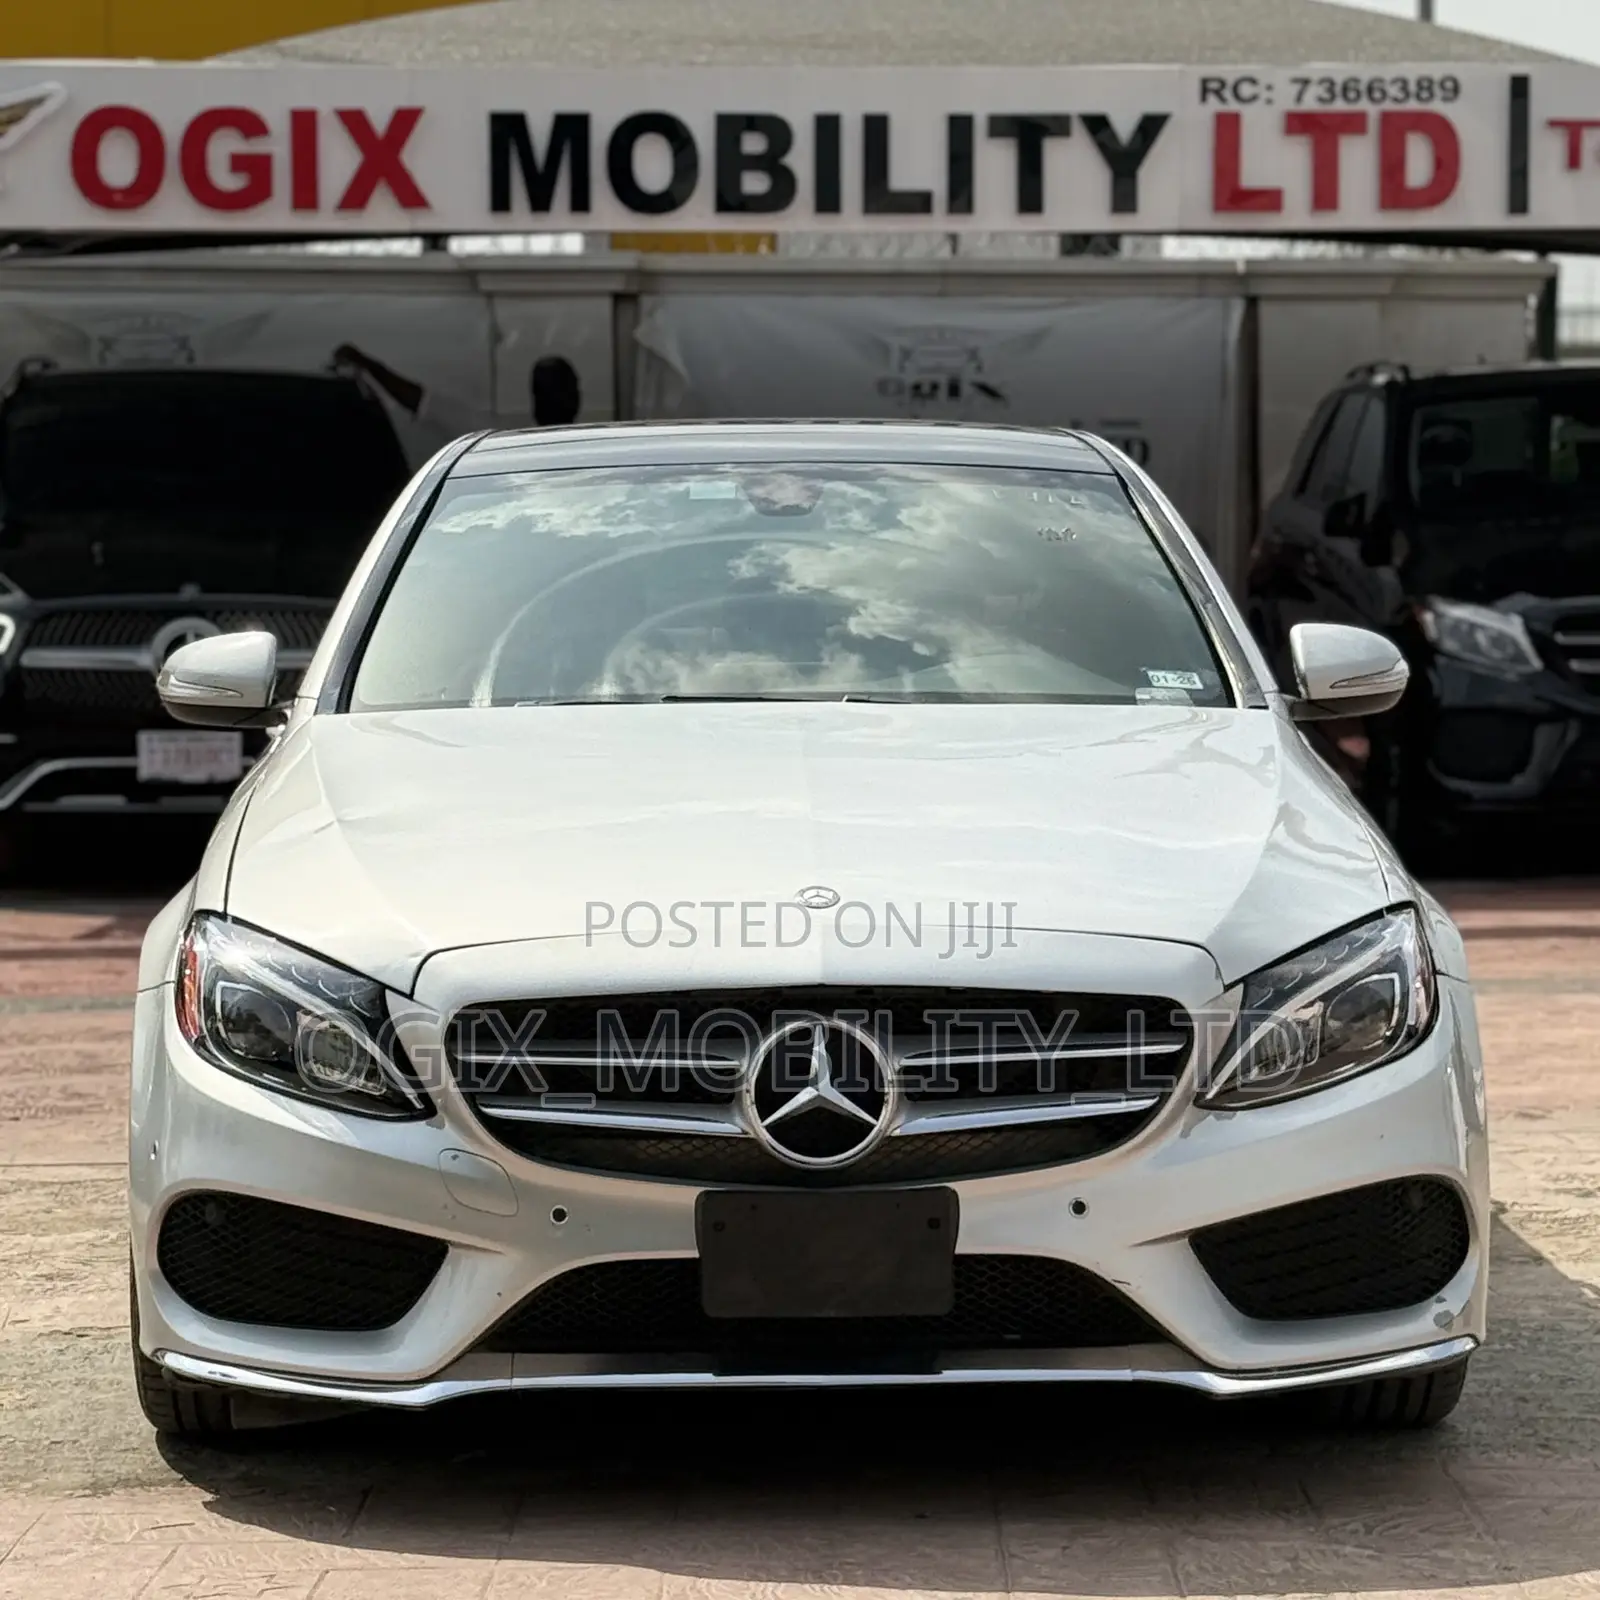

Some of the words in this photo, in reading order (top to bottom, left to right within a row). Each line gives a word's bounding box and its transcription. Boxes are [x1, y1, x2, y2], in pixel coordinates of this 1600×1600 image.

[1199, 76, 1275, 105] RC:
[1290, 75, 1462, 105] 7366389
[70, 105, 432, 213] OGIX
[488, 111, 1172, 215] MOBILITY
[1212, 110, 1462, 214] LTD
[1546, 117, 1600, 171] T
